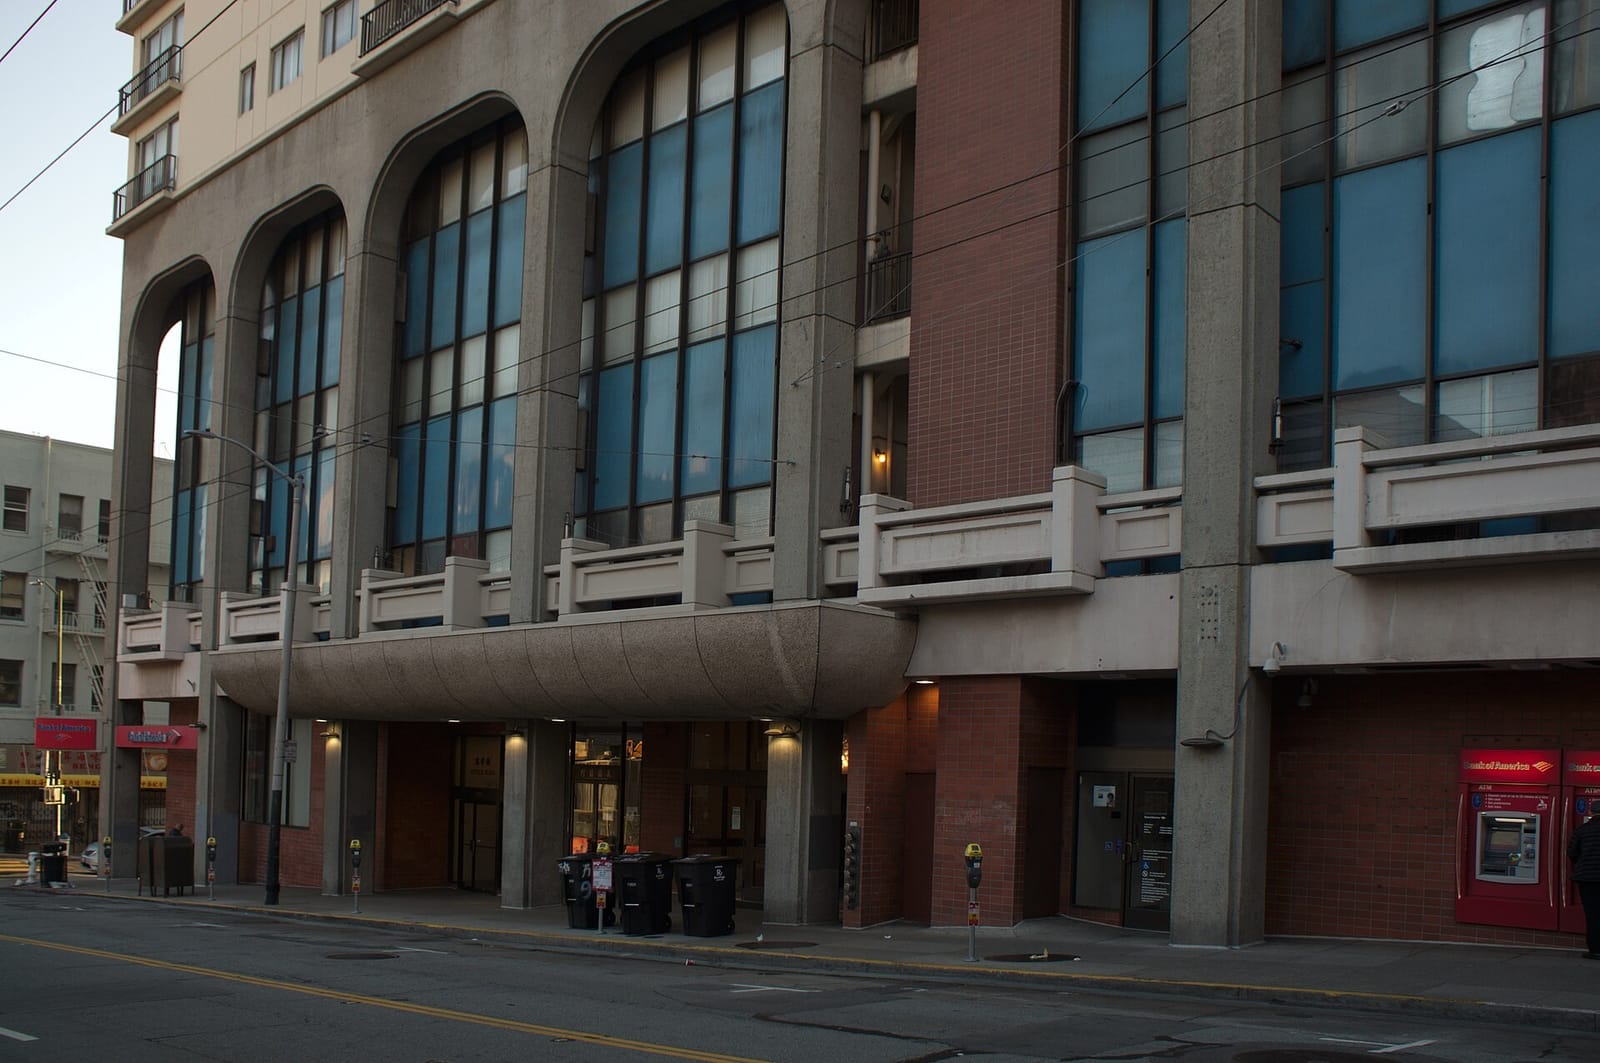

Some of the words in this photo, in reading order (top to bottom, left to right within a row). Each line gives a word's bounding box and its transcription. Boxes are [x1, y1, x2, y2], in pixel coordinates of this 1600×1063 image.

[1463, 761, 1486, 770] Bank
[1486, 761, 1495, 770] of
[1495, 761, 1530, 771] America
[1568, 763, 1592, 772] Bank
